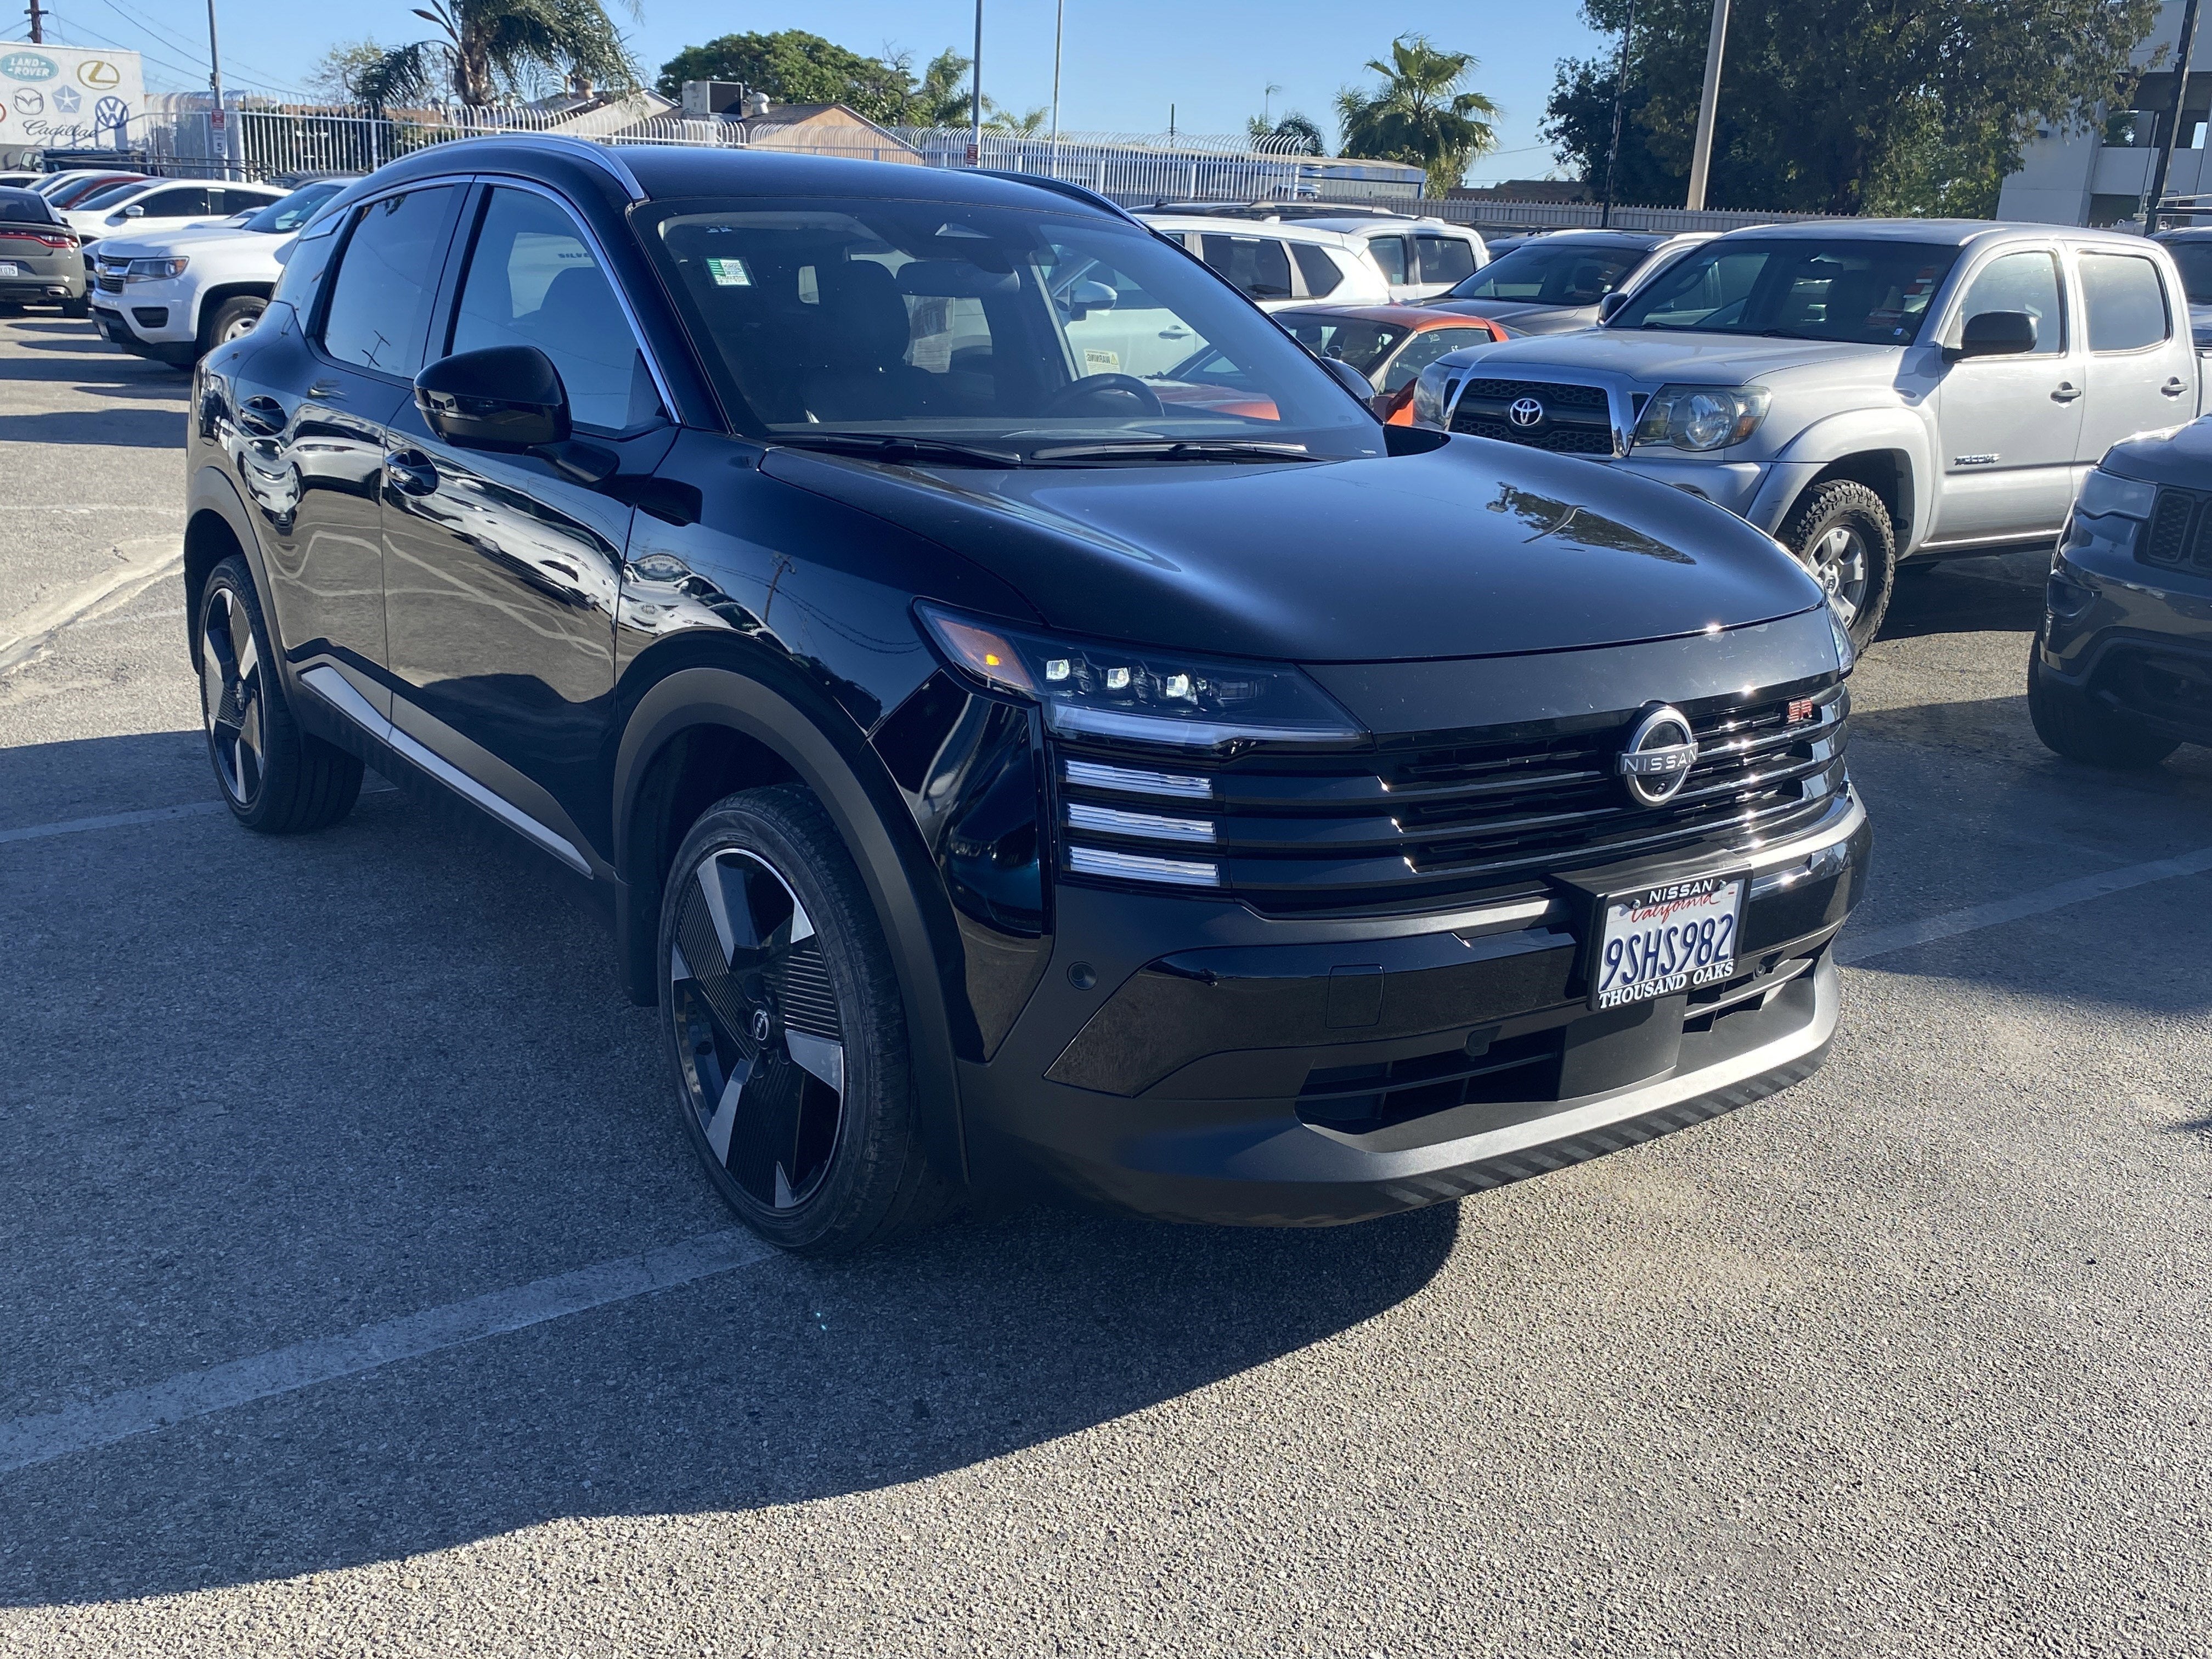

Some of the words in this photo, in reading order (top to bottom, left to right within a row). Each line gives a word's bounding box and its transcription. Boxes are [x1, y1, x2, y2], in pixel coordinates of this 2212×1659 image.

[22, 120, 97, 137] Cadillac
[217, 143, 223, 151] 5
[1787, 699, 1813, 723] SR
[1623, 747, 1697, 772] NISSAN
[1649, 879, 1713, 904] NISSAN
[1631, 893, 1720, 924] California
[1600, 913, 1734, 991] 9SHS982
[1599, 973, 1687, 1009] THOUSAND
[1692, 961, 1734, 985] OAKS
